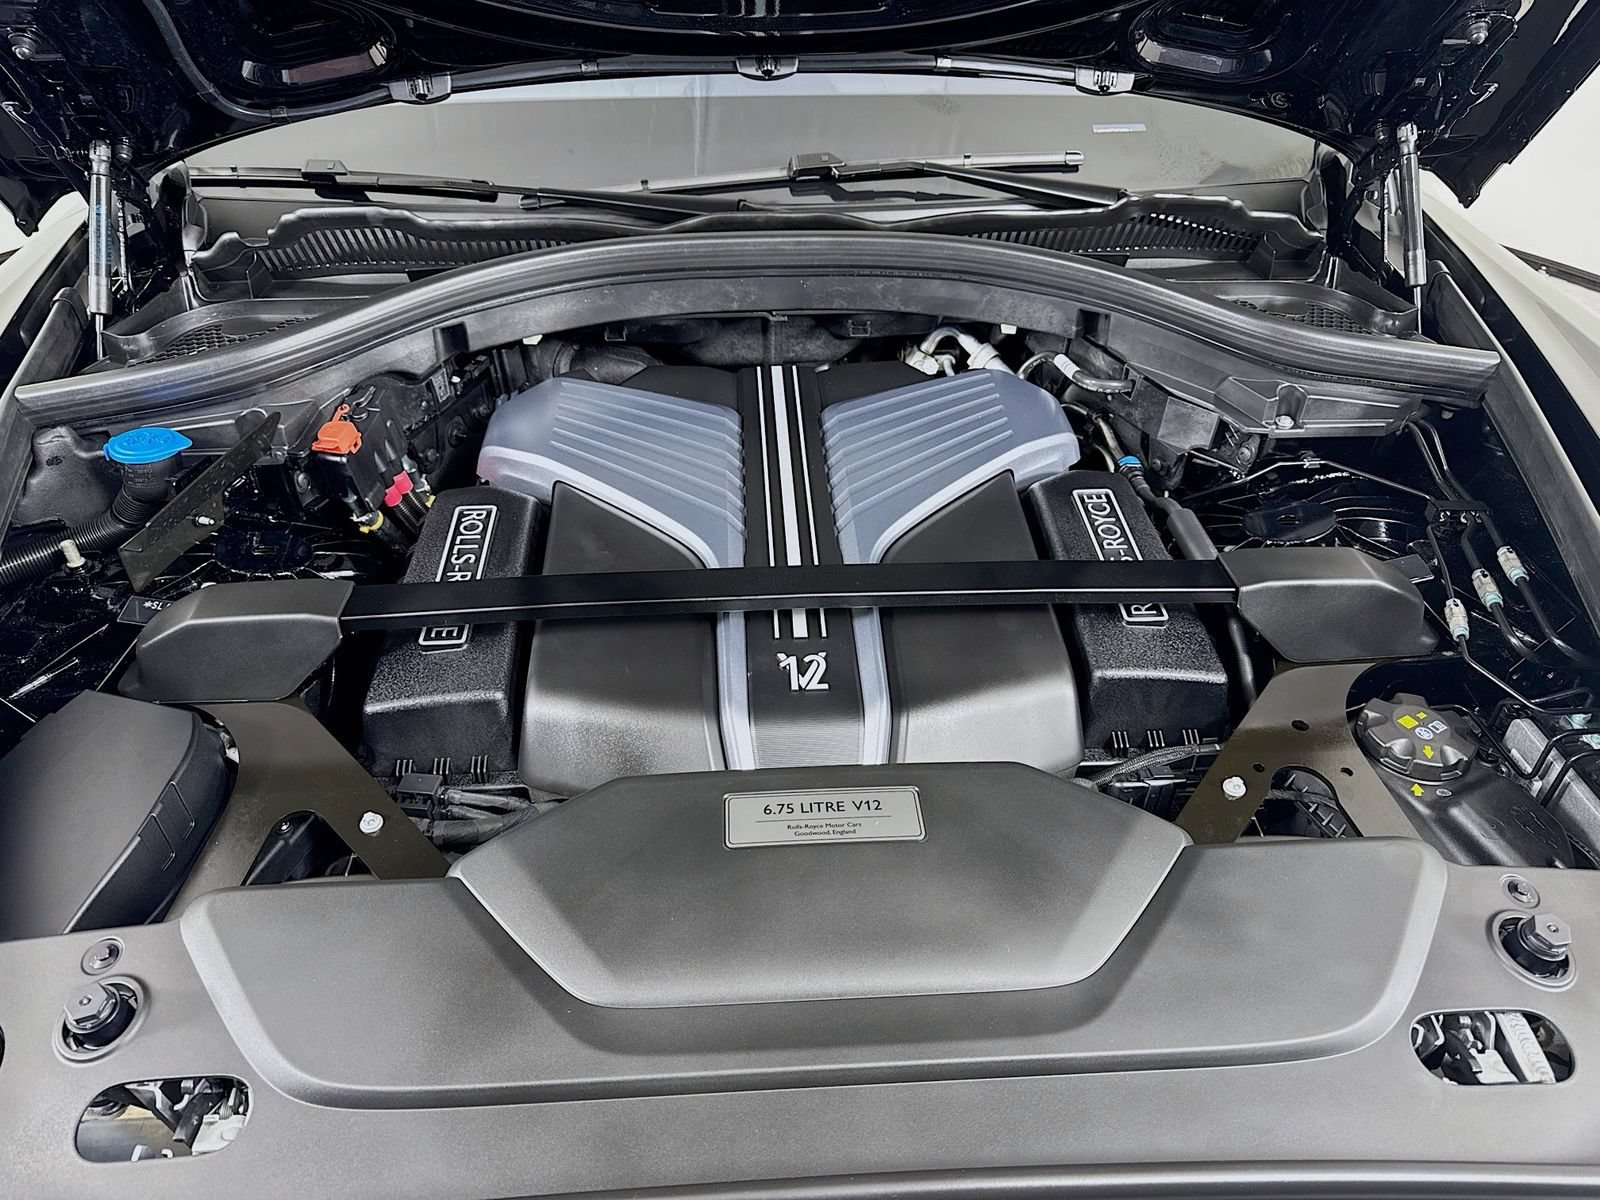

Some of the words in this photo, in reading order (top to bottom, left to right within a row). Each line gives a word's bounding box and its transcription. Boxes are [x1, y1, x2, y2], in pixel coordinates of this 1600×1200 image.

[763, 803, 795, 815] 6.75
[800, 801, 845, 814] LITRE
[851, 800, 883, 811] V12
